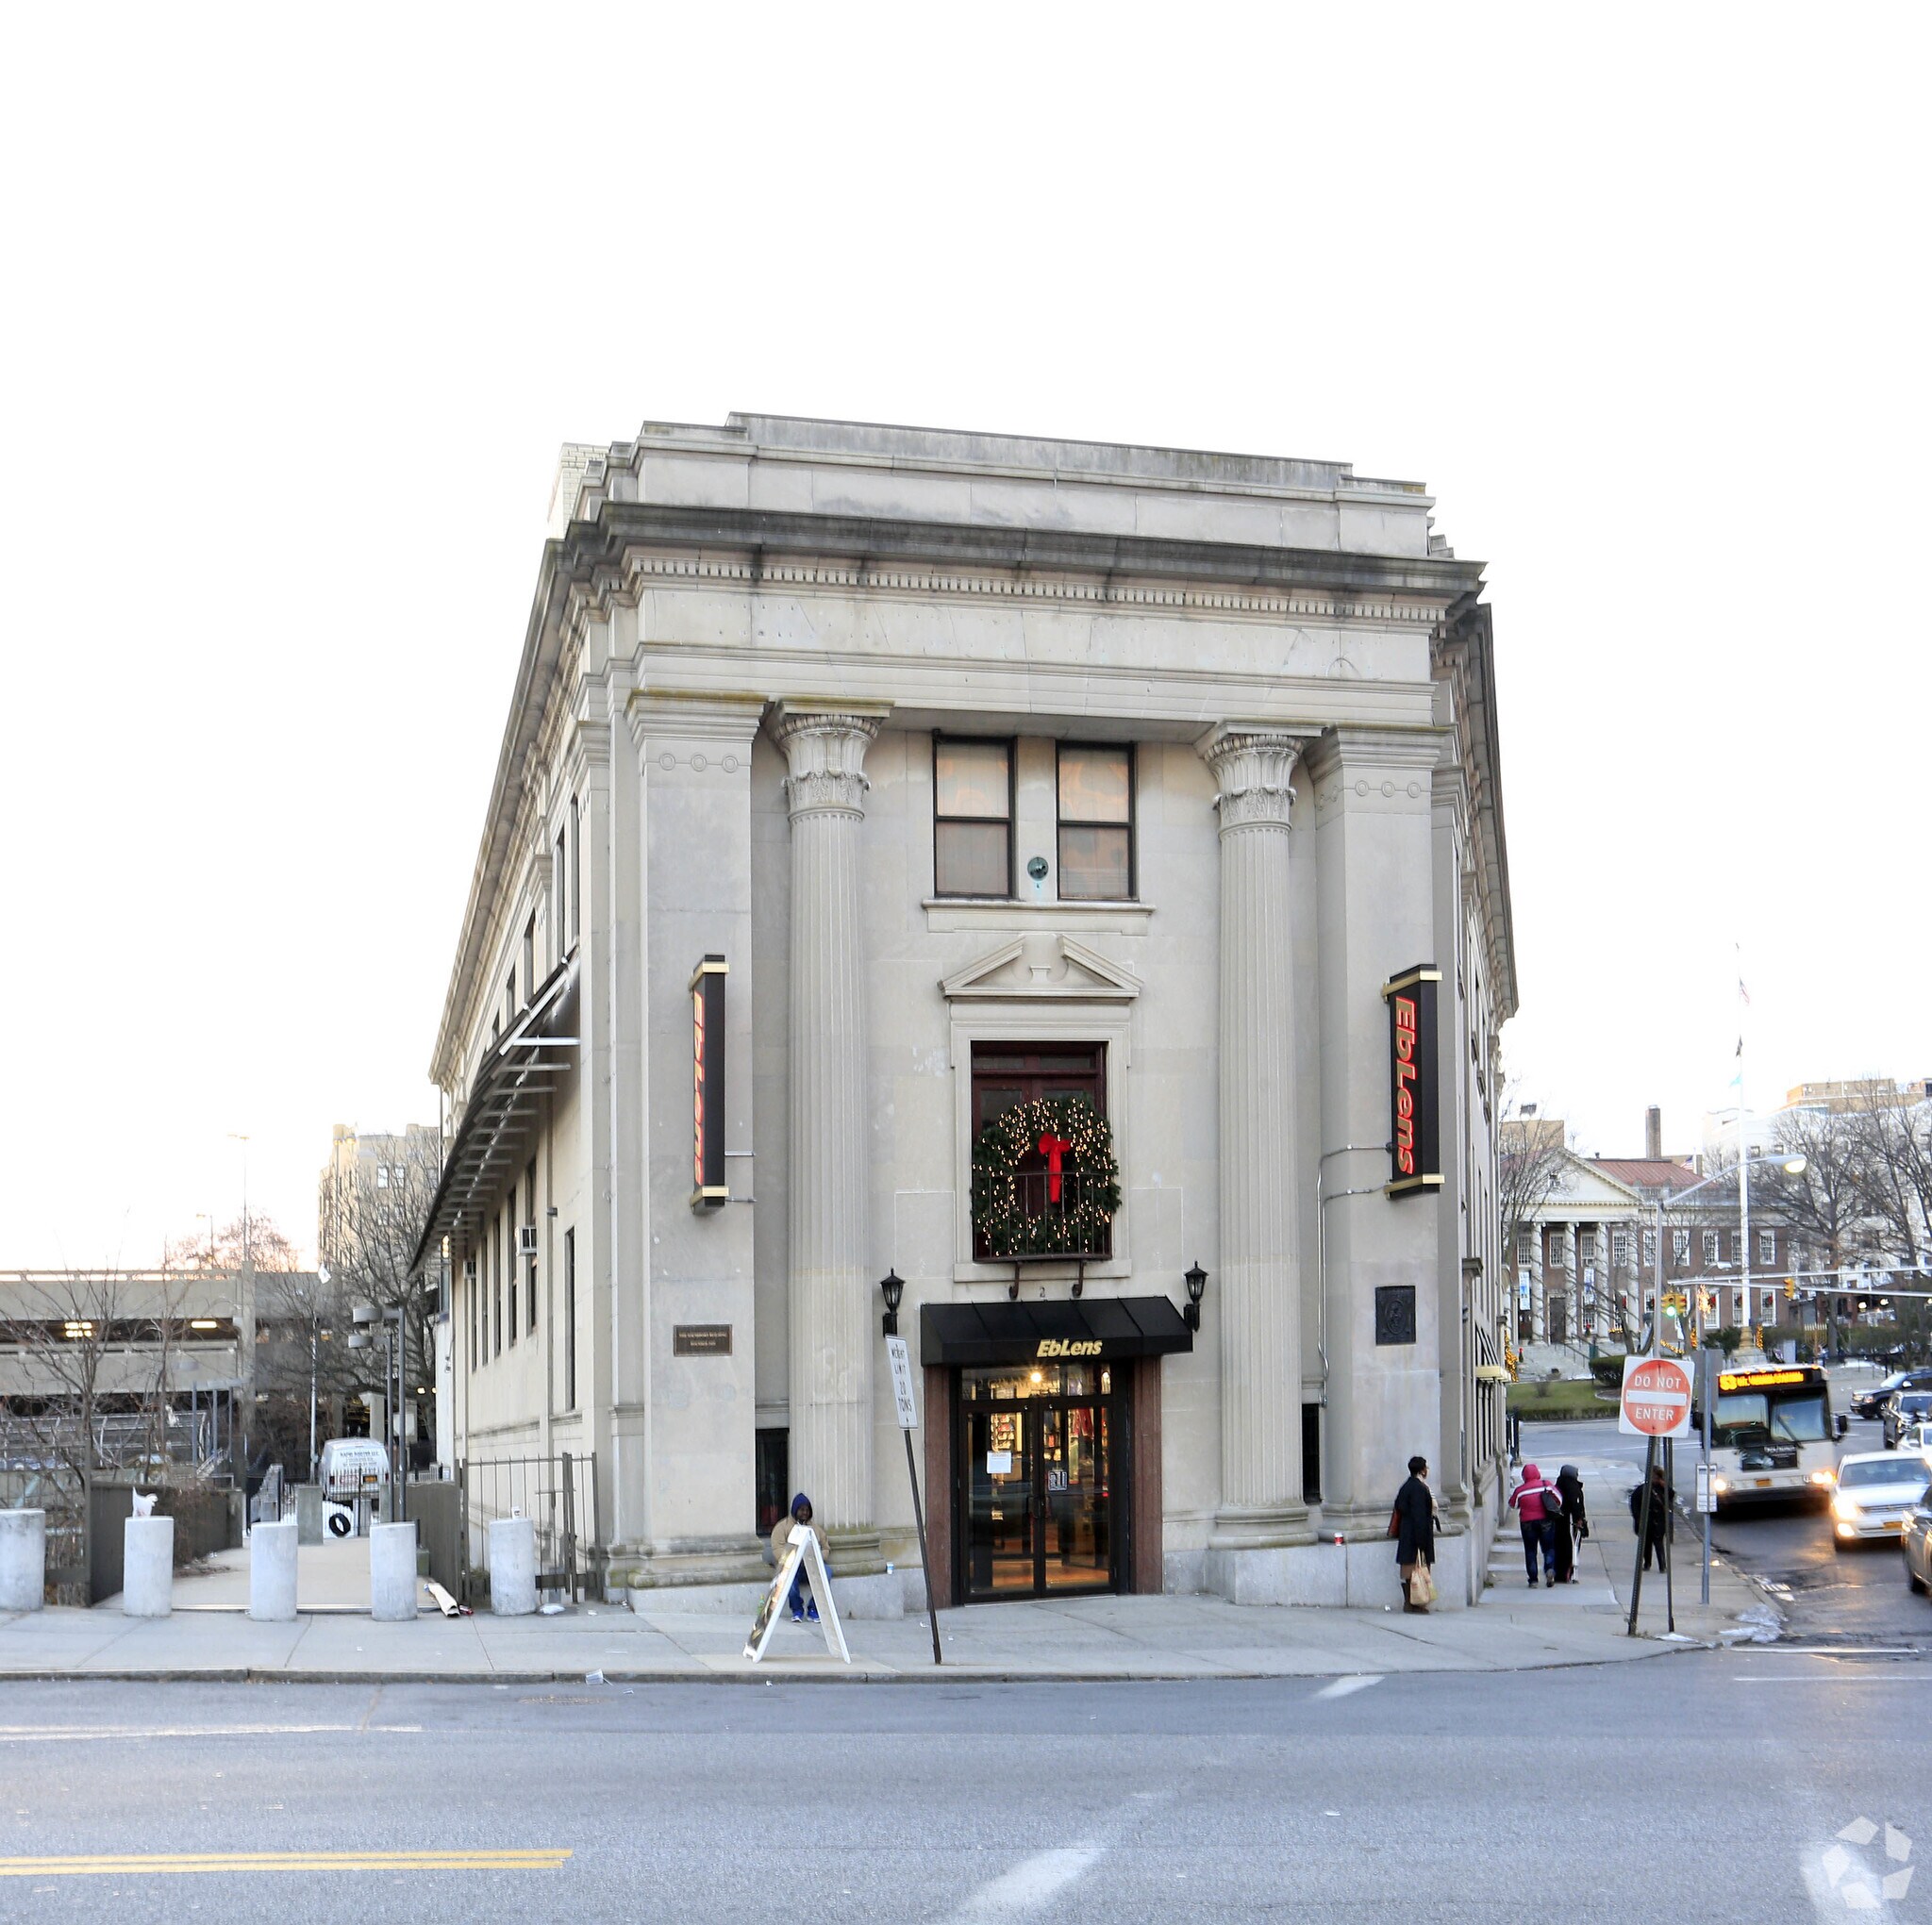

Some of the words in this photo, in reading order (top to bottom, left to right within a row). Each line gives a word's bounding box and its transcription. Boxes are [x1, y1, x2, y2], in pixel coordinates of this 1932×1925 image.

[1395, 996, 1416, 1175] EbLens
[1037, 1338, 1103, 1357] EbLens
[1634, 1375, 1651, 1387] DO
[1657, 1376, 1682, 1389] NOT
[898, 1398, 912, 1412] TONS
[1635, 1406, 1674, 1421] ENTER
